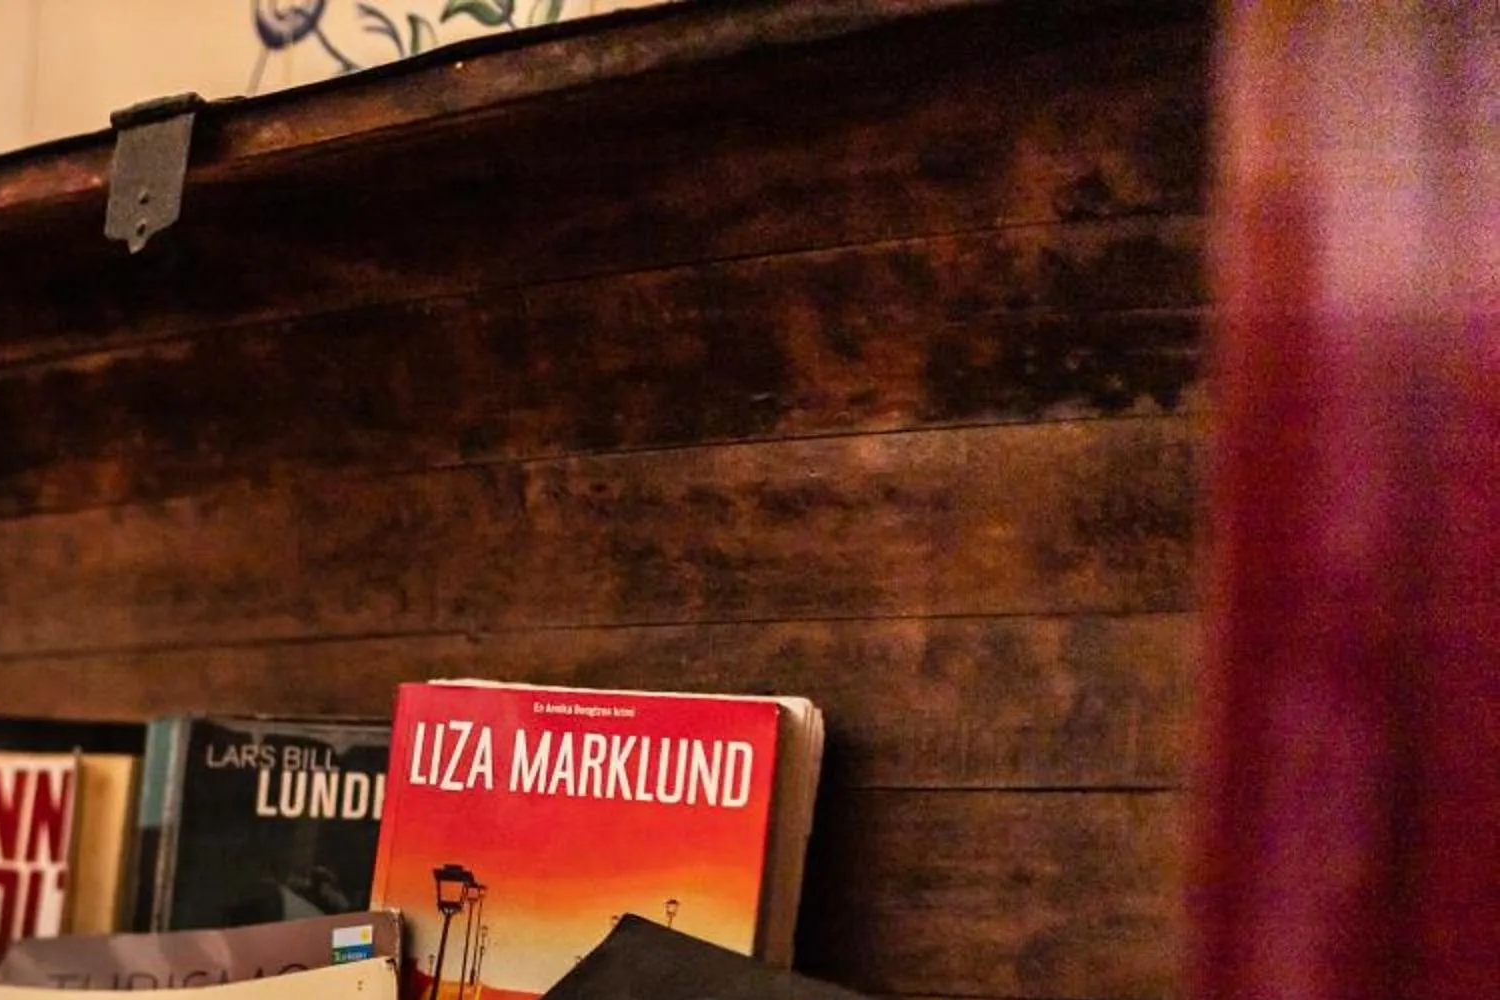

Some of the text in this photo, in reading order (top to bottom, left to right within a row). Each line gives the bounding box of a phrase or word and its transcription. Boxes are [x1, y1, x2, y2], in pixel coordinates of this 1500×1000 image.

[206, 743, 340, 772] LARS BILL
[409, 720, 754, 808] LIZA MARKLUND
